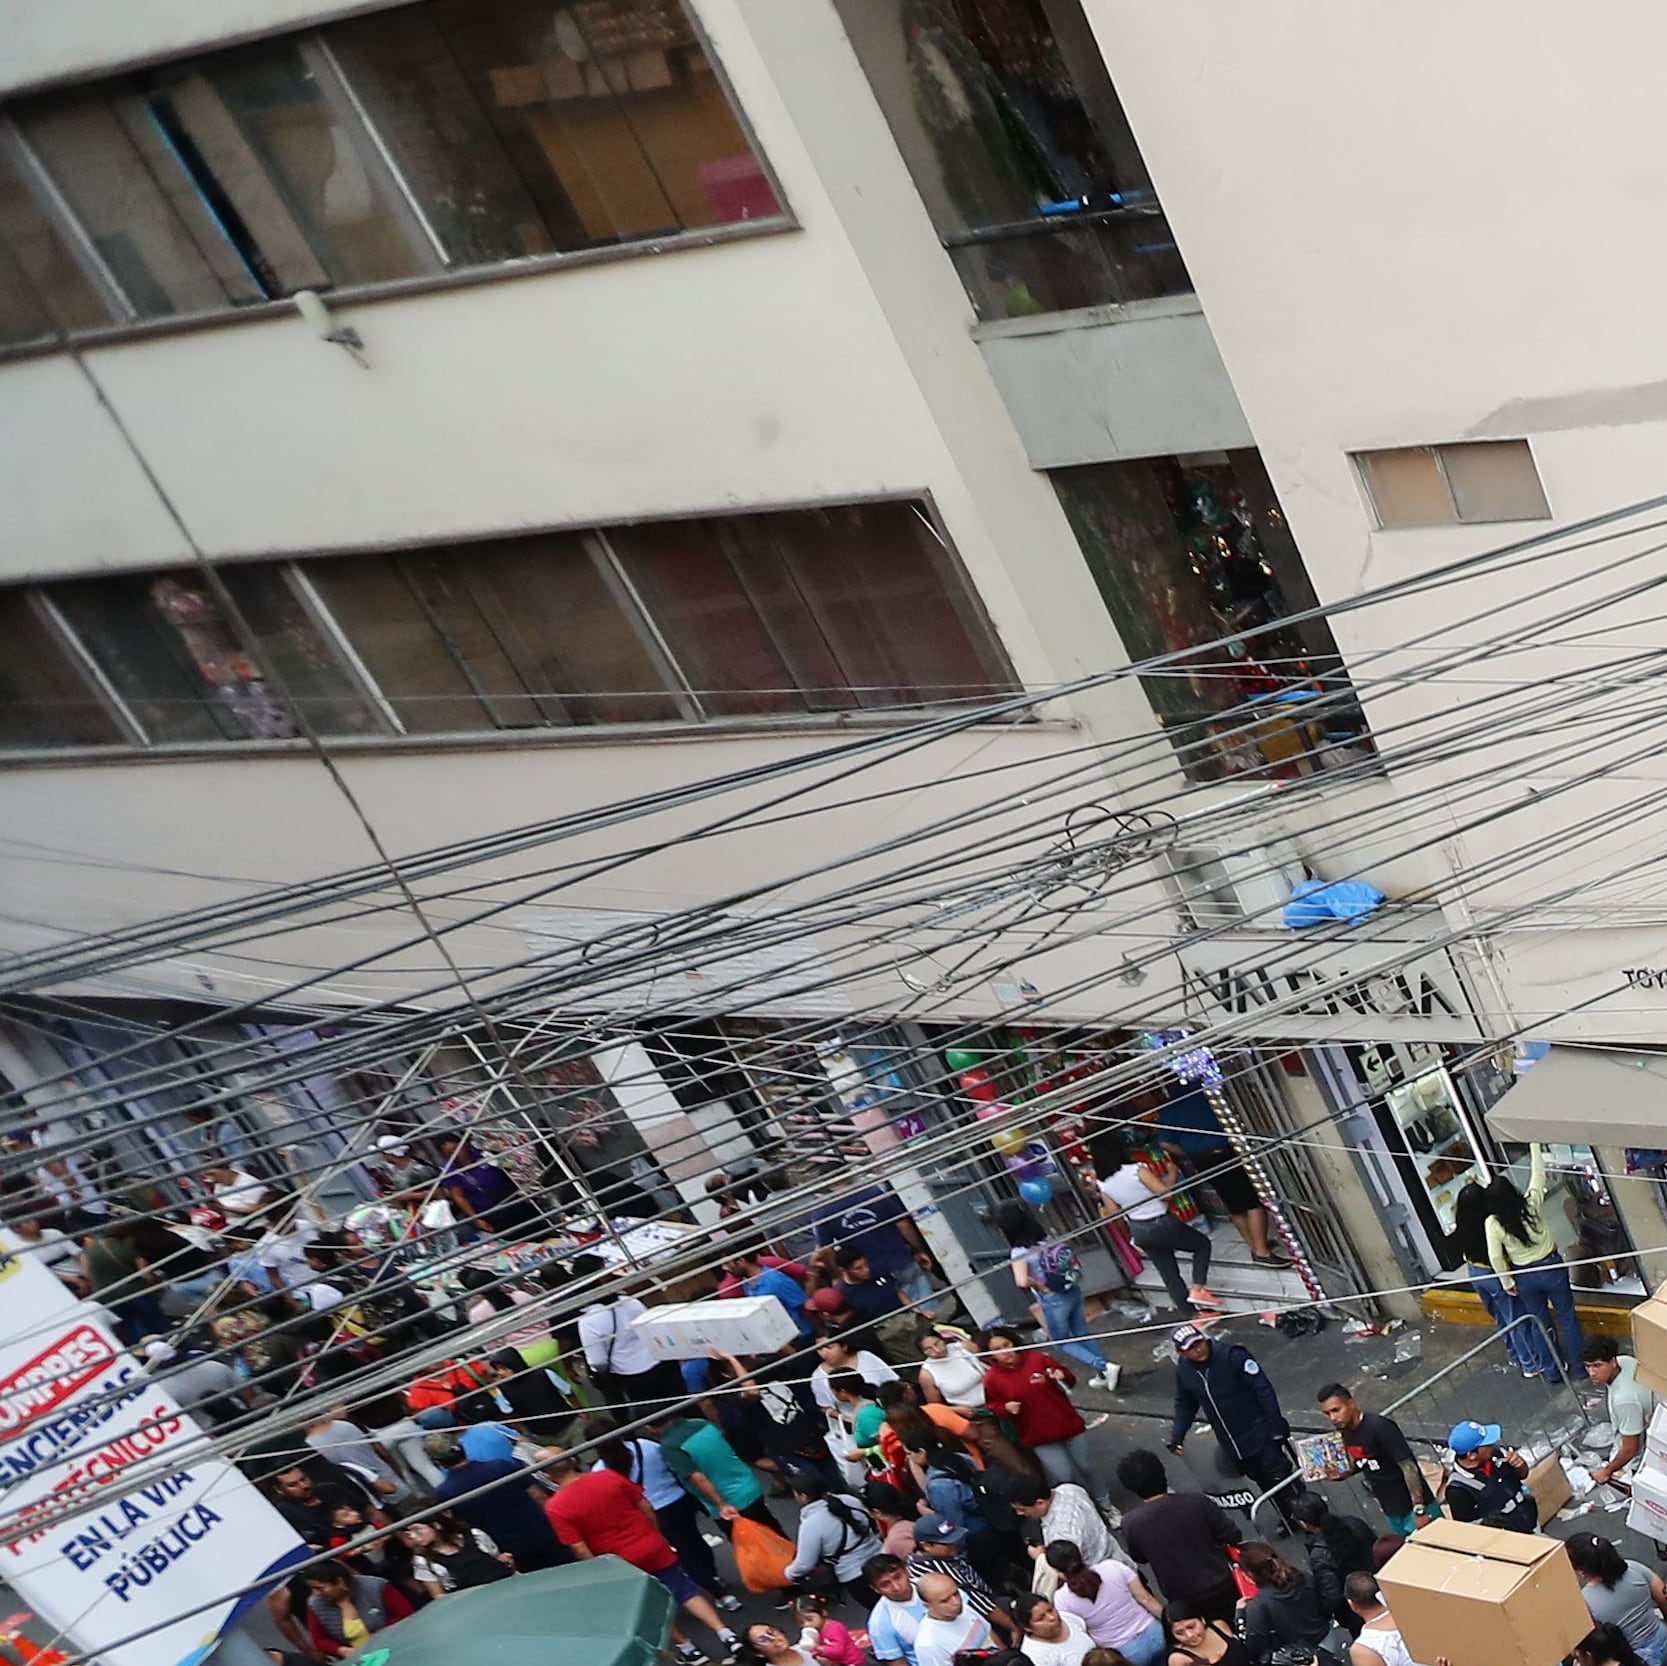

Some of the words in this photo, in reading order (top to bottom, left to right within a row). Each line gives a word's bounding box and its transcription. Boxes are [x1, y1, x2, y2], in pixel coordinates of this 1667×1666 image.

[61, 1522, 113, 1573] EN
[101, 1498, 150, 1542] LA
[105, 1502, 222, 1603] PÚBLICA
